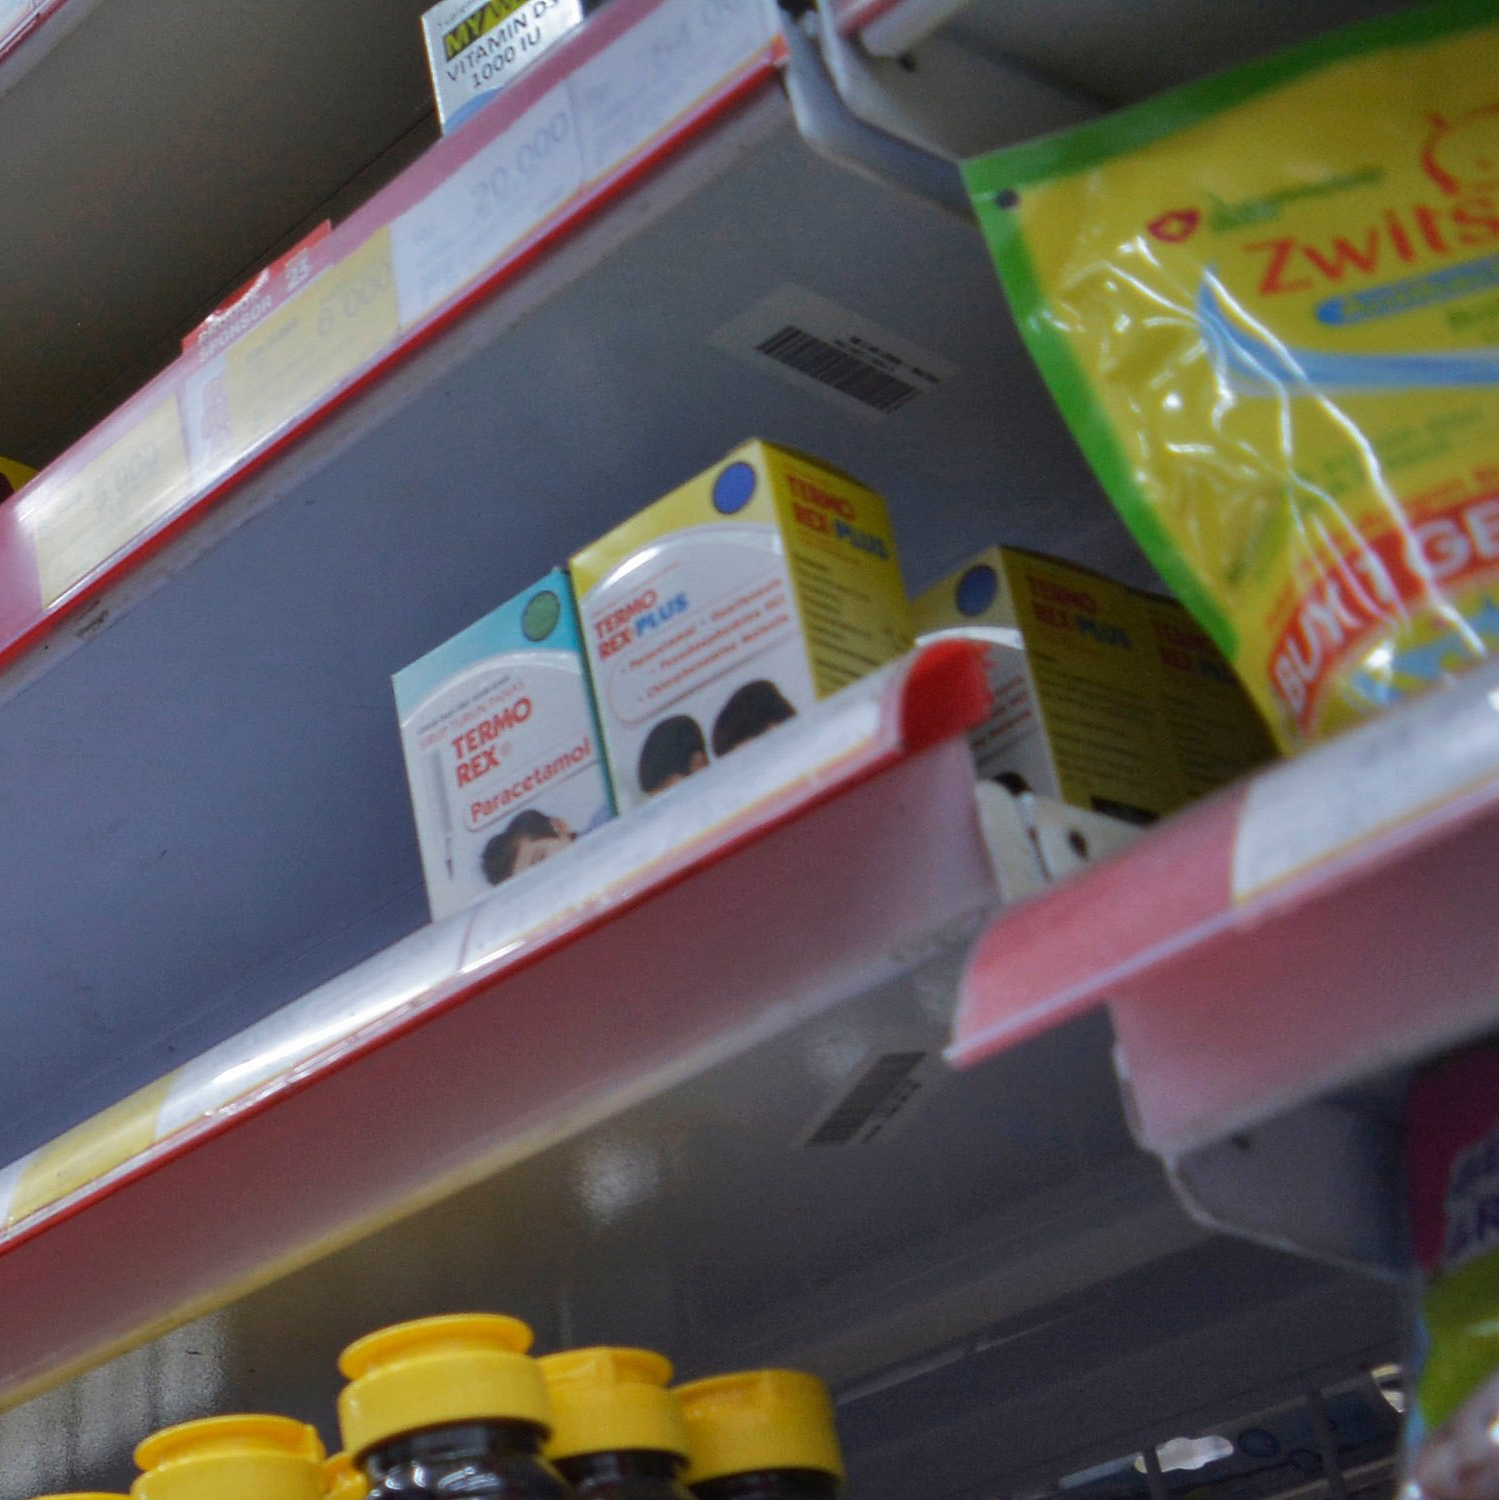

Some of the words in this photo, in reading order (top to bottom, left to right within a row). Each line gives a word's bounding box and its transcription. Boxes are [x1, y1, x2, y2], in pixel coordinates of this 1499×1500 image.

[445, 17, 526, 83] VITAMIN
[471, 46, 518, 88] 1000
[518, 26, 543, 60] IU
[788, 474, 856, 522] TERMO
[792, 501, 829, 535] REX
[594, 588, 659, 638] TERMO
[598, 627, 633, 661] REX
[635, 592, 689, 637] PLUS
[452, 697, 533, 760] TERMO
[456, 742, 500, 788] REX
[469, 736, 592, 824] Paracetamol
